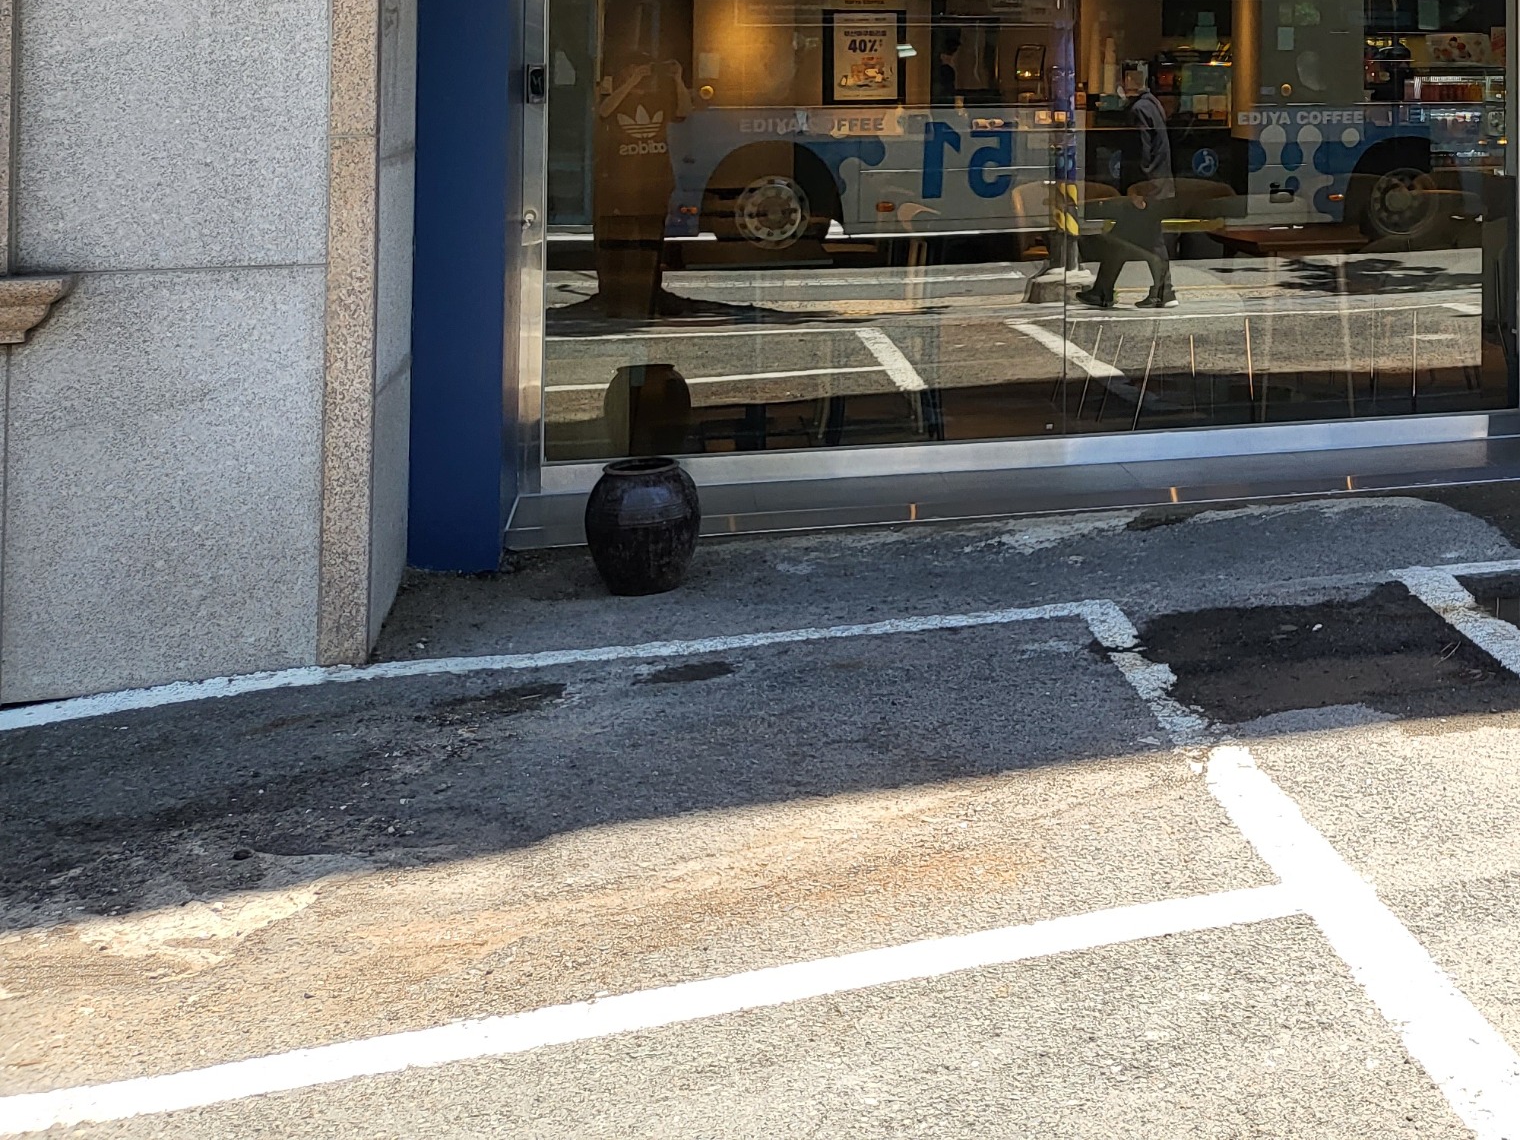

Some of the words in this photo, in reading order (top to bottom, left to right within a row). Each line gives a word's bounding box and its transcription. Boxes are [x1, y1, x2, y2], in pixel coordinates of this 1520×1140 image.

[848, 39, 878, 53] 40%
[1237, 111, 1291, 125] EDIYA
[1296, 110, 1364, 124] COFFEE
